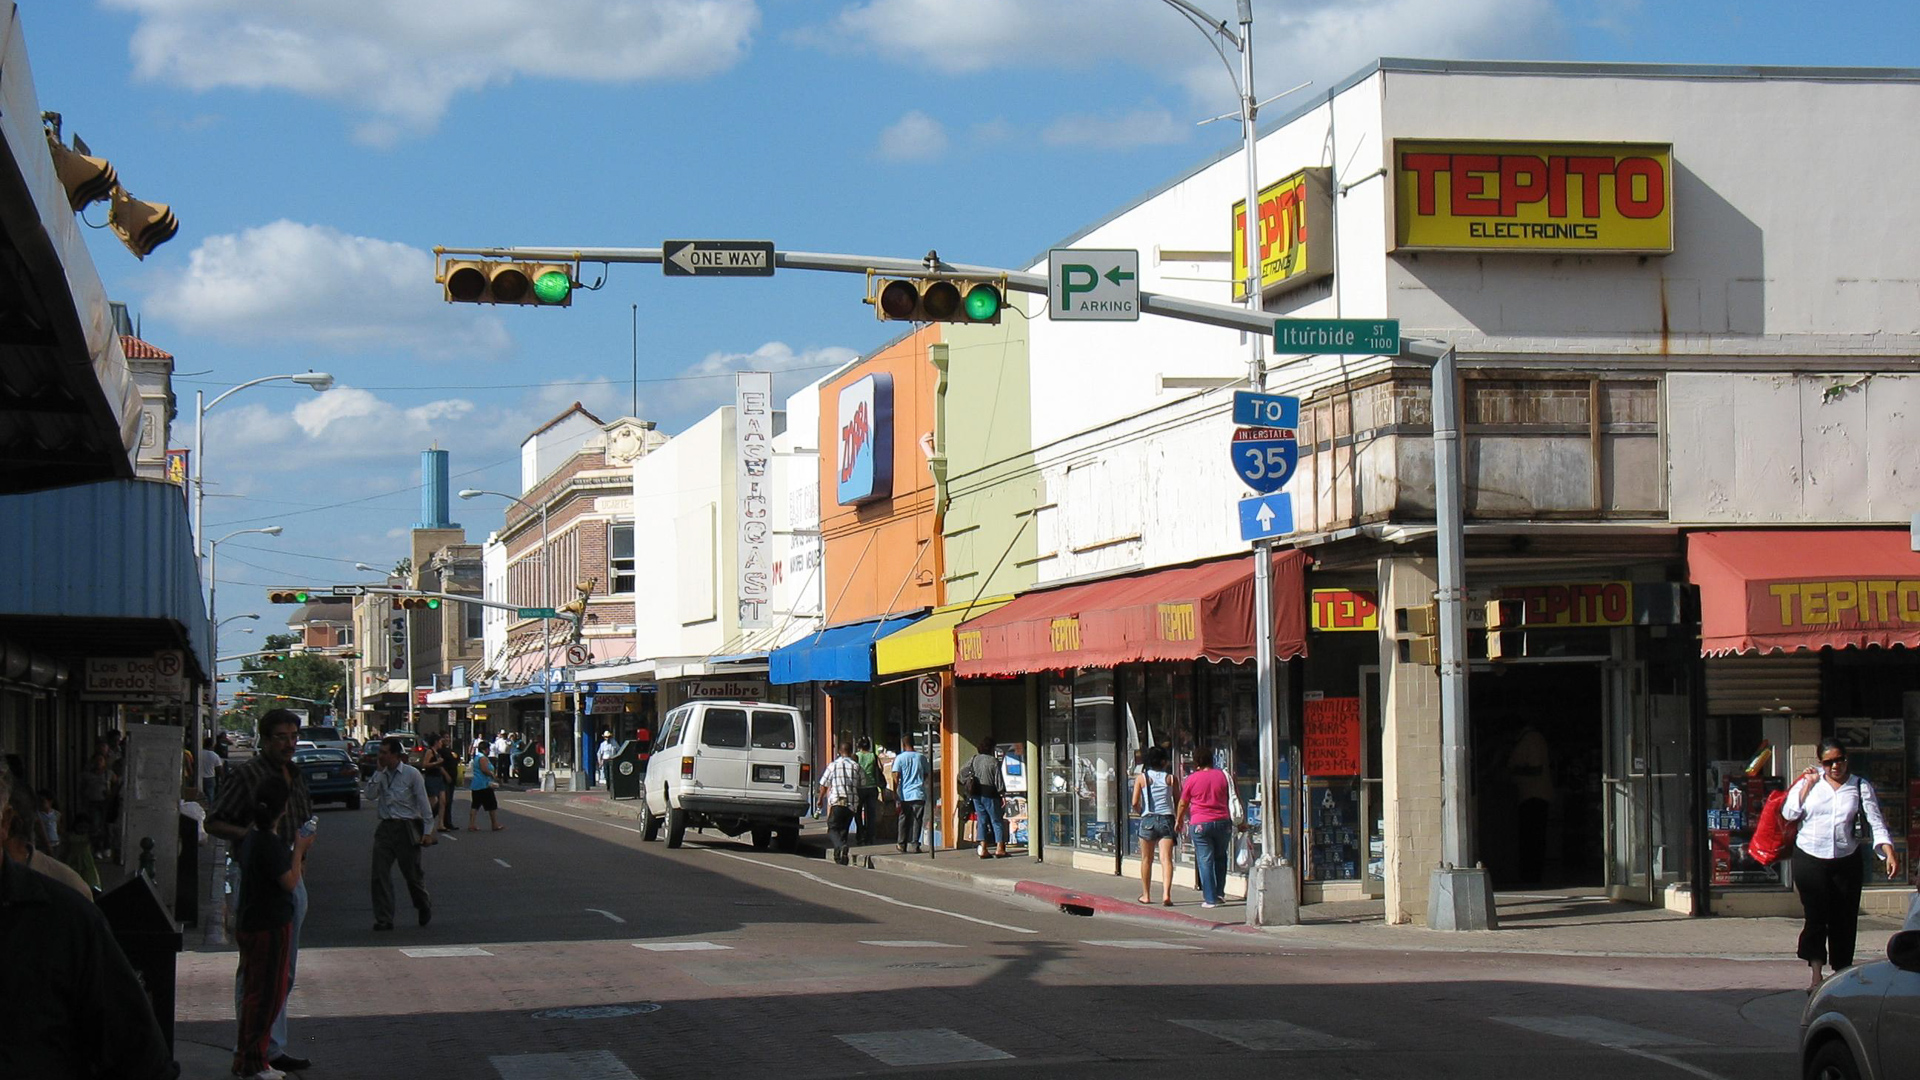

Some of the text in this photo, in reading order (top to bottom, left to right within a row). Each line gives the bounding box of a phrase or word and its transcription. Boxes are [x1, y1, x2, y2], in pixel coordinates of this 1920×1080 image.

[1401, 153, 1664, 219] TEPITO
[1469, 222, 1598, 239] ELECTRONICS
[690, 252, 760, 265] ONE WAY
[1284, 325, 1384, 346] Iturbide ST
[1370, 338, 1393, 349] 1100
[1251, 399, 1282, 421] TO
[1239, 429, 1288, 440] INTERSTATE
[1245, 447, 1287, 480] 35
[1157, 603, 1195, 641] TEPITO
[91, 661, 155, 673] Los Dos
[89, 675, 155, 688] Laredo's
[692, 682, 759, 696] Zonalibre
